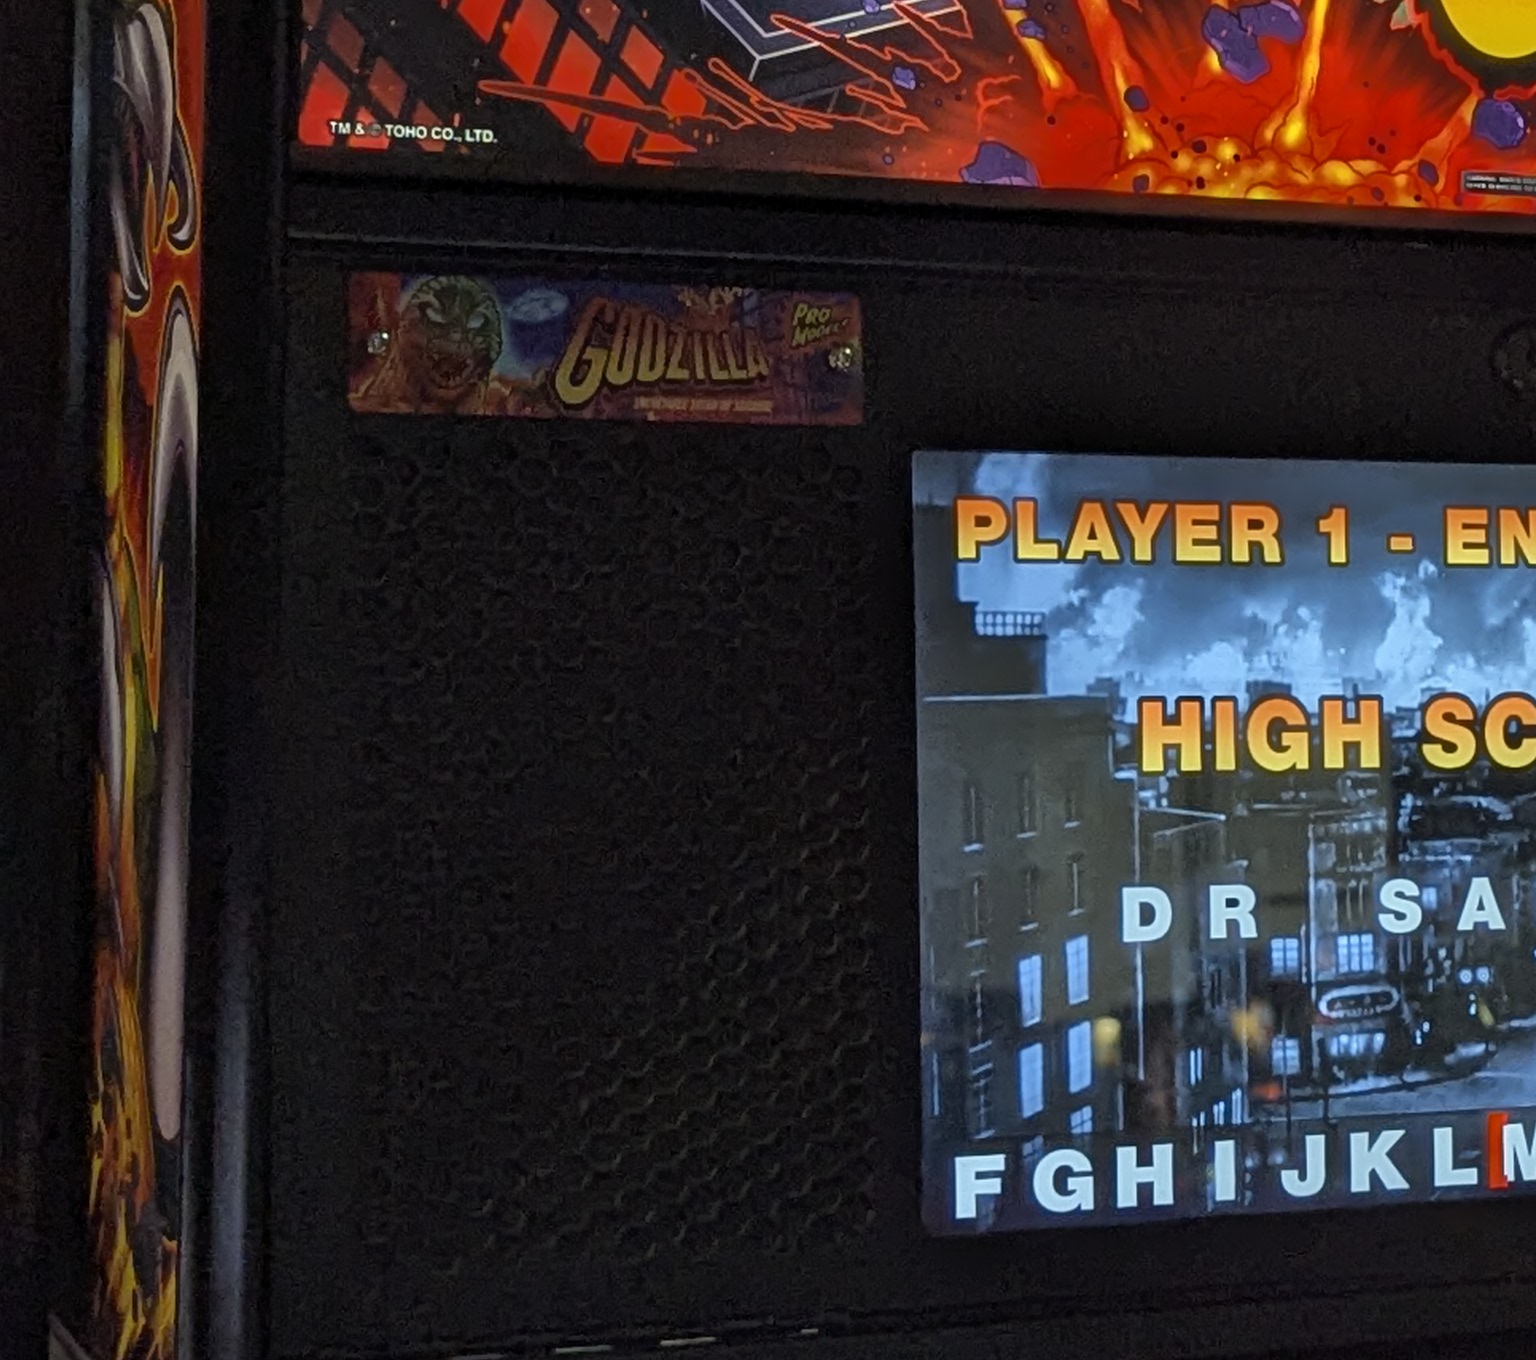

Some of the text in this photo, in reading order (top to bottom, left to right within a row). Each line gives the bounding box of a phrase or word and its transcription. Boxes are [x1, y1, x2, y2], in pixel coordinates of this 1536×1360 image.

[329, 121, 351, 135] TM
[354, 123, 365, 136] &
[384, 124, 428, 139] TOHO
[464, 128, 499, 144] LTD.
[793, 301, 833, 325] PRO
[554, 294, 771, 406] GODZILLA
[954, 496, 1283, 566] PLAYER
[1314, 505, 1352, 566] 1
[1136, 693, 1385, 777] HIGH
